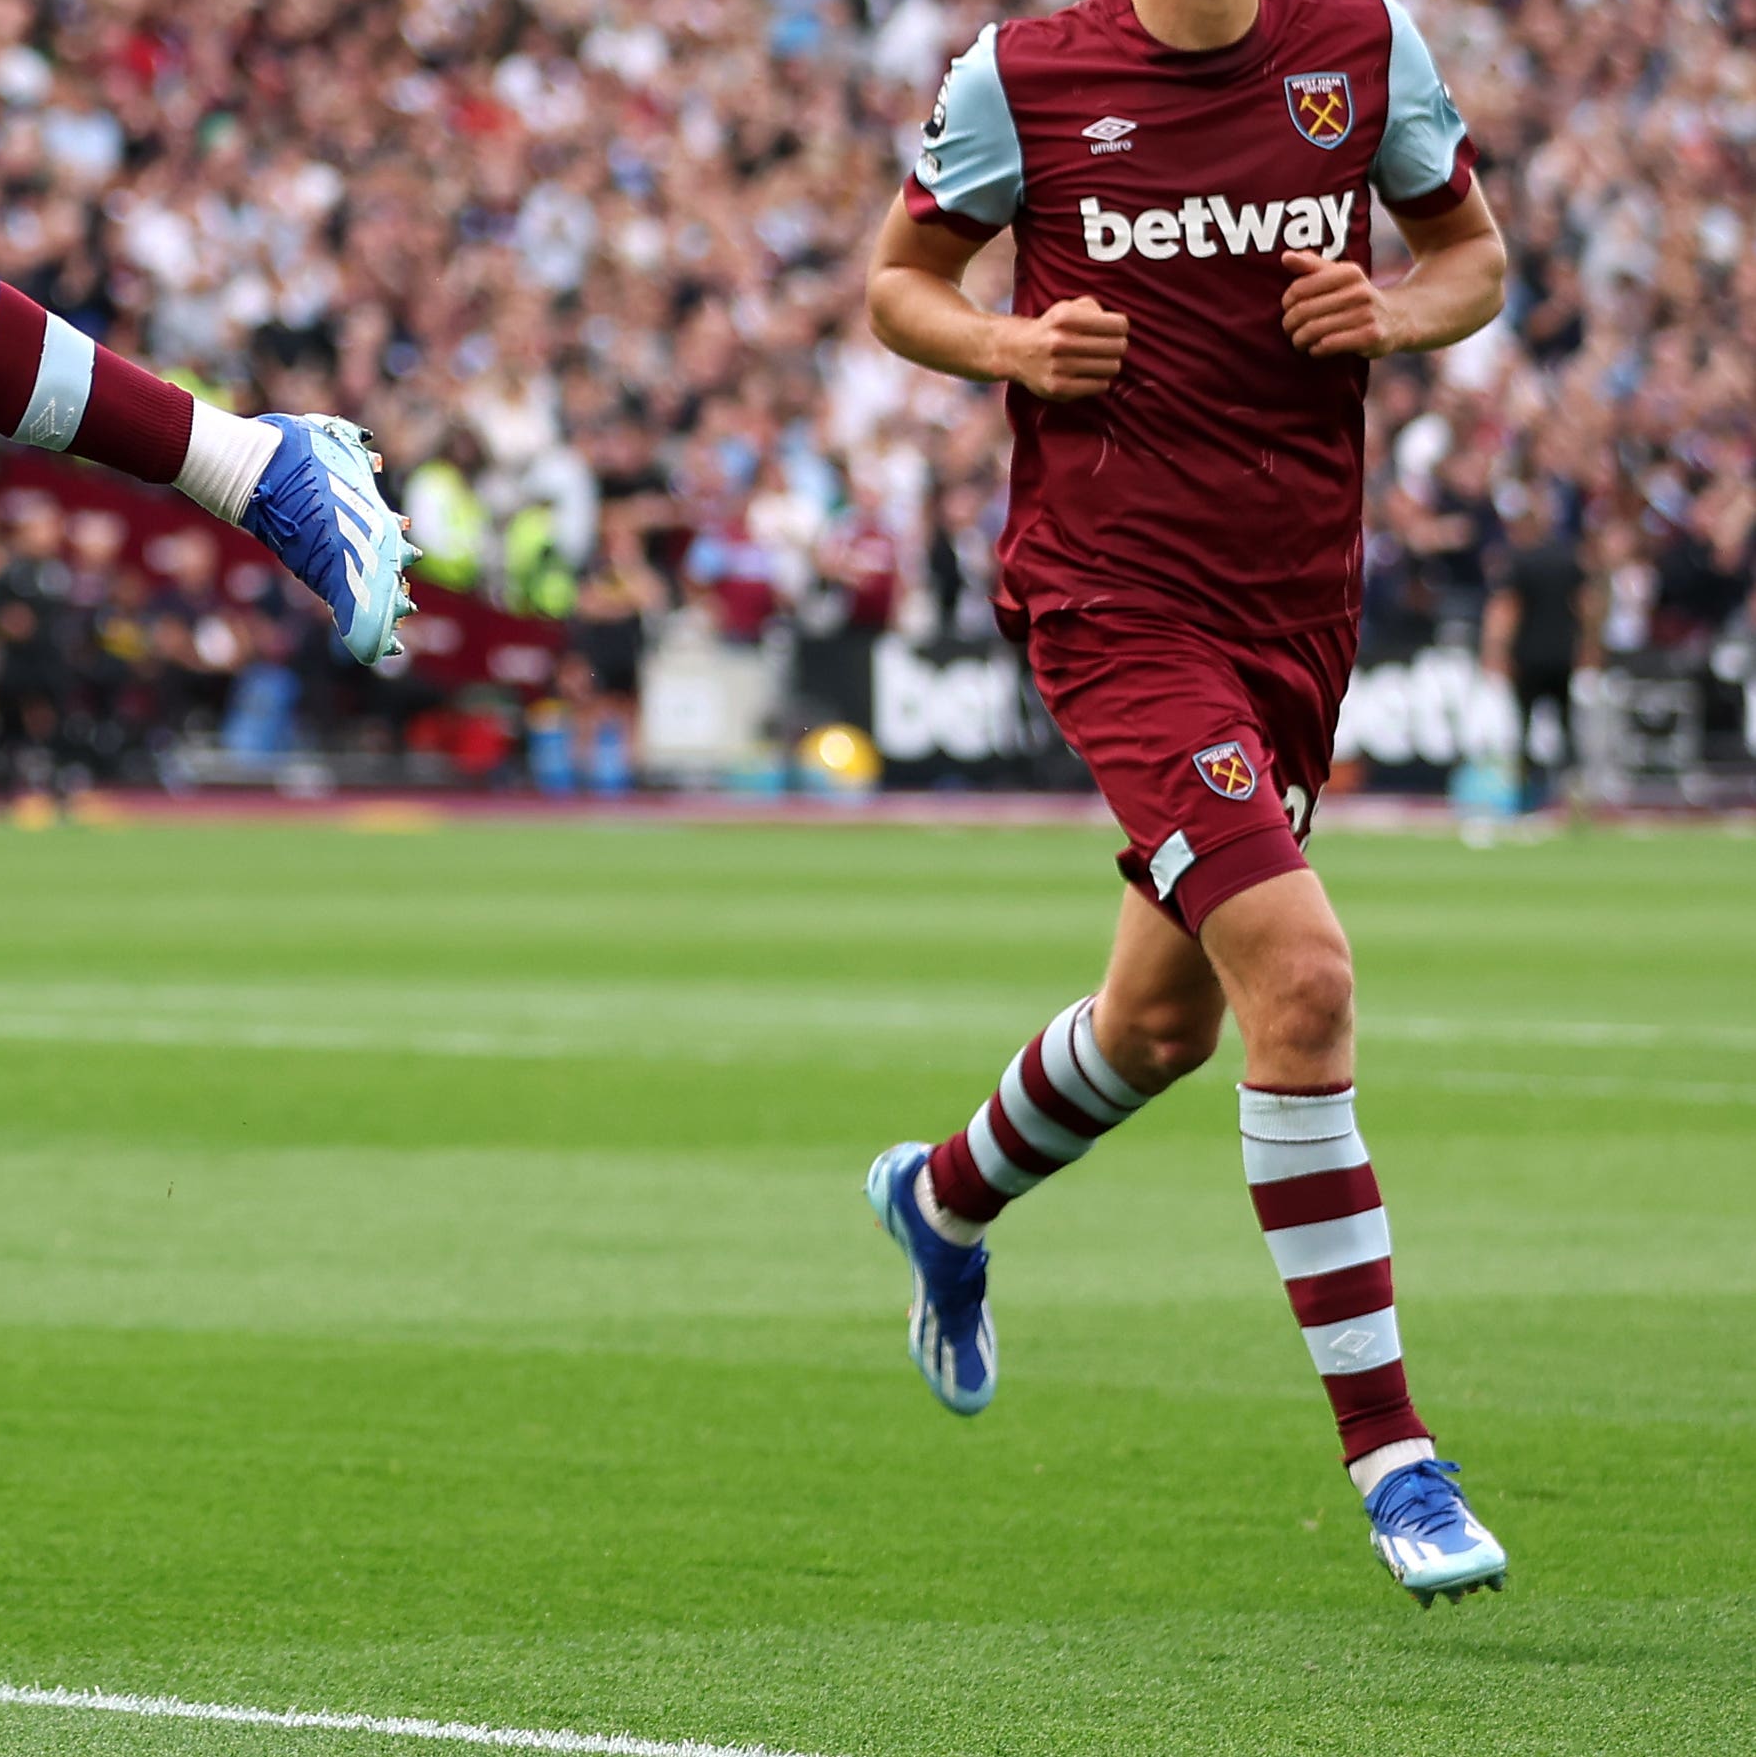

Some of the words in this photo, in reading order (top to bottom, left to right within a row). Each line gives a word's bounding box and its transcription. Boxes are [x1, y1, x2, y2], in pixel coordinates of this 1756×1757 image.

[1090, 140, 1133, 155] umbro
[1079, 189, 1355, 262] betway
[870, 632, 1032, 762] bet
